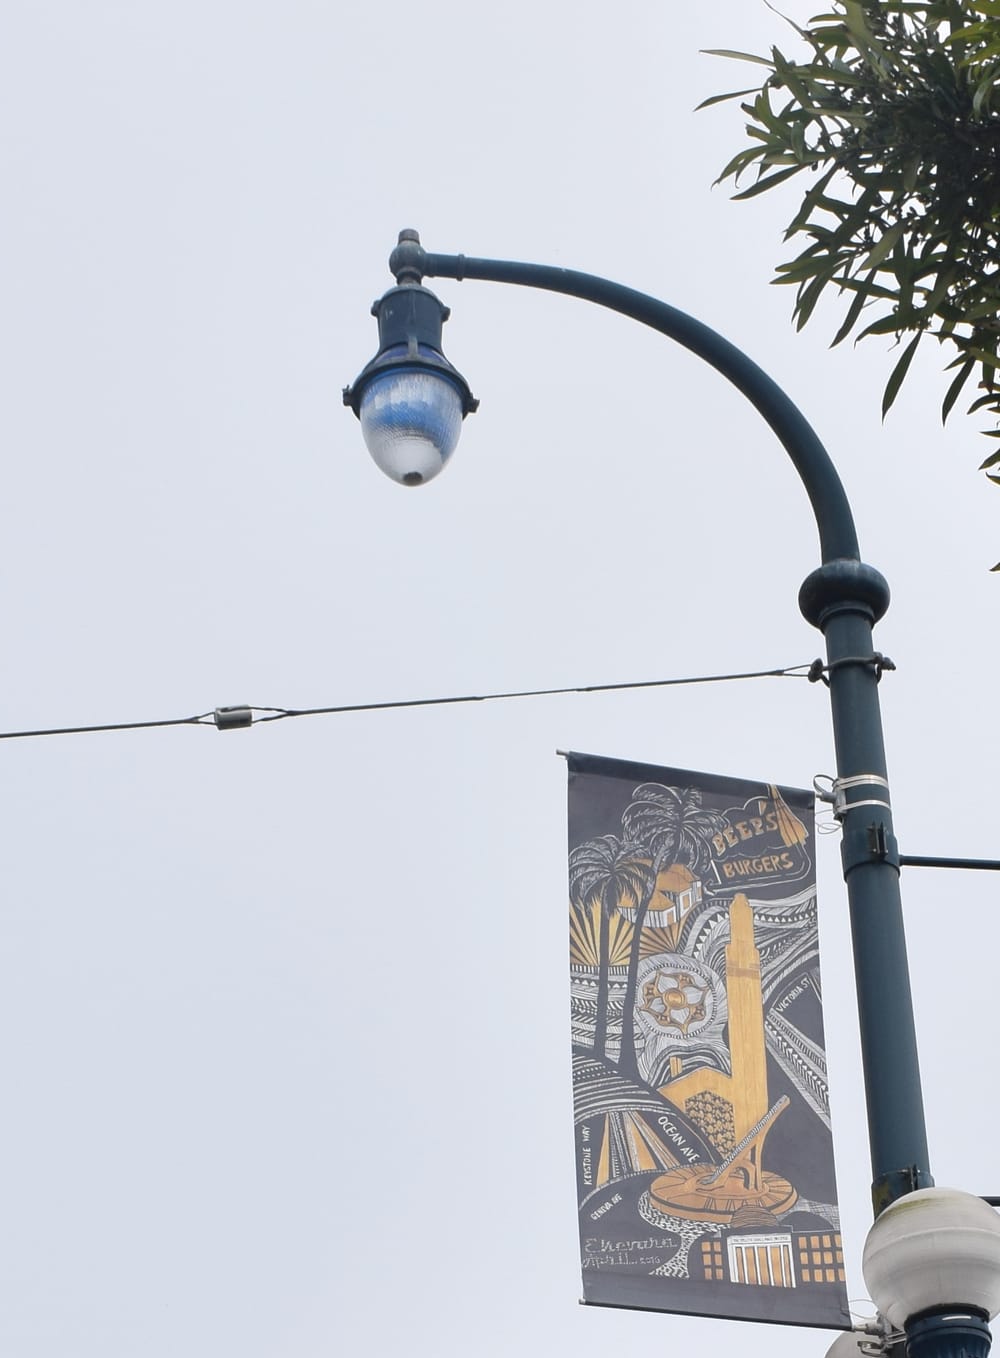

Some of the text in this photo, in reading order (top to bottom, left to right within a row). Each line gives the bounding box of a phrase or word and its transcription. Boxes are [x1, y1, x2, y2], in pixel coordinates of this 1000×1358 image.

[722, 852, 794, 879] BURGERS
[775, 977, 810, 1012] VICTORIA ST
[658, 1116, 700, 1163] OCEAN AVE
[582, 1147, 593, 1186] KEYSTONE
[590, 1201, 613, 1221] GENEVA
